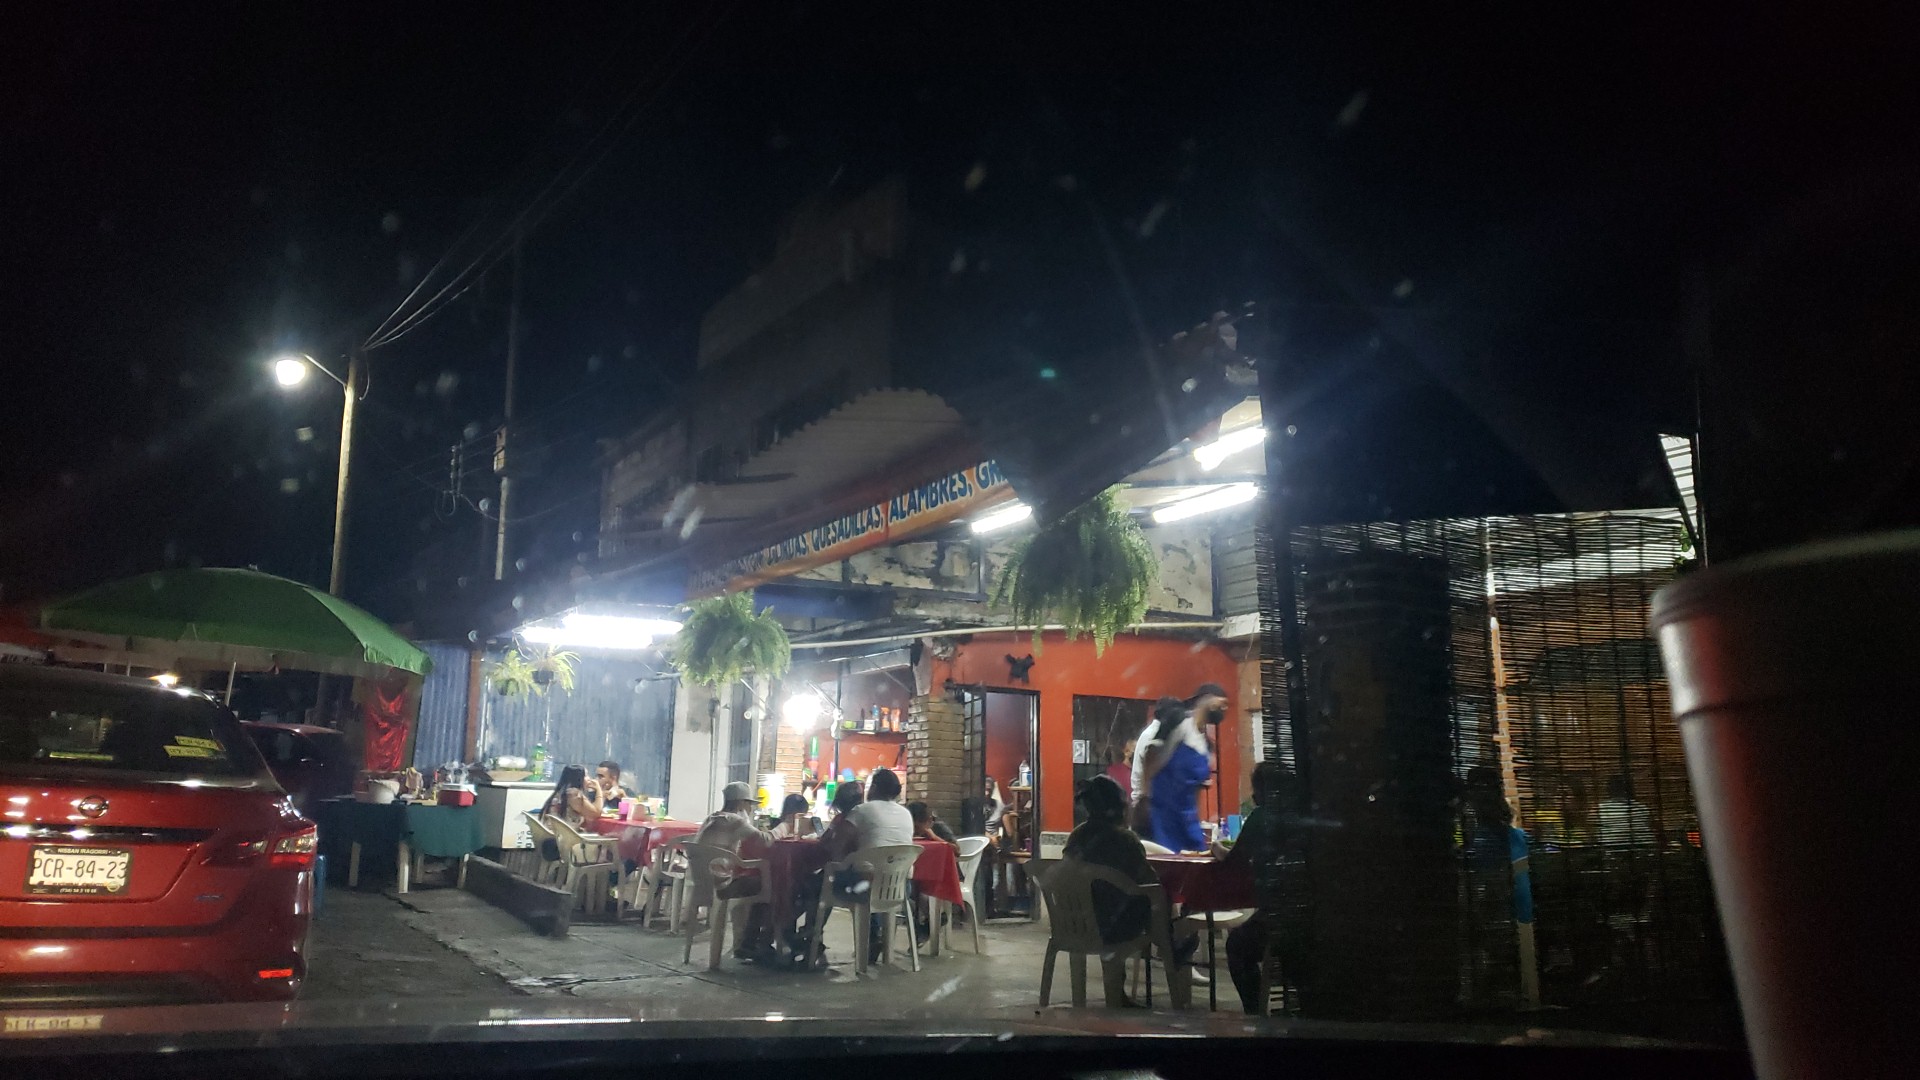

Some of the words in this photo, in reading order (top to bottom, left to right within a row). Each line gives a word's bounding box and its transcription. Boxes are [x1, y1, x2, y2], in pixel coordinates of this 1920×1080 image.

[811, 505, 885, 552] QUESADILLAS,
[889, 471, 974, 523] ALAMBRES,
[975, 459, 1008, 489] GR
[34, 858, 127, 879] PCR-84-23
